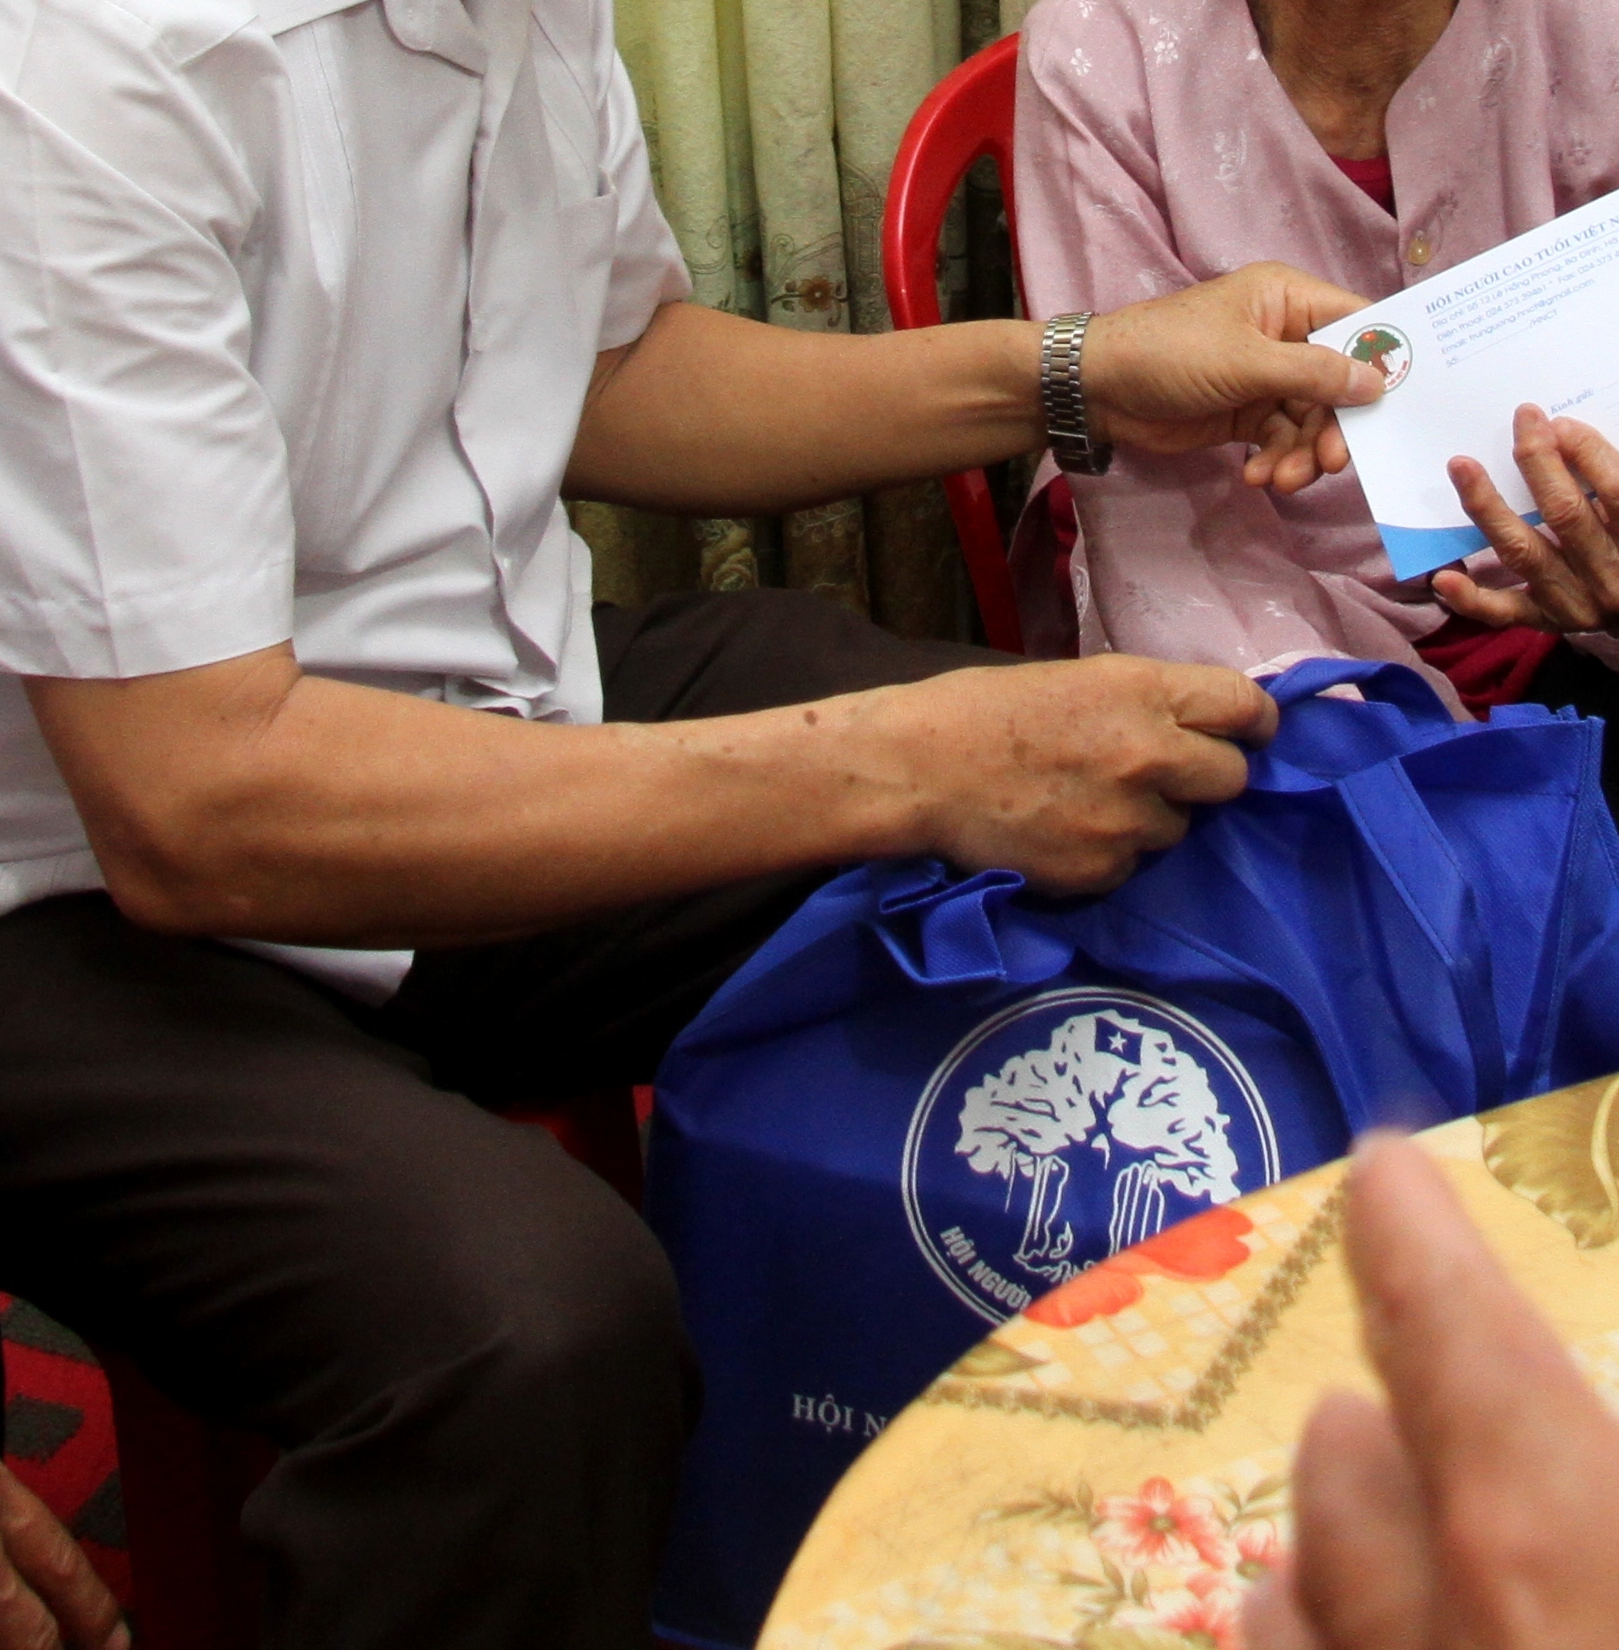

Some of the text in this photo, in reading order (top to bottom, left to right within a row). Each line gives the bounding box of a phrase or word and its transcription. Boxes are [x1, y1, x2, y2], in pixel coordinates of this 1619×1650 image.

[1426, 295, 1452, 314] HỘI
[1454, 272, 1500, 297] NGƯỜI
[1502, 257, 1533, 276] CAO
[1573, 223, 1605, 242] VIỆT
[940, 1226, 977, 1265] HỘI
[791, 1393, 854, 1433] HỘI
